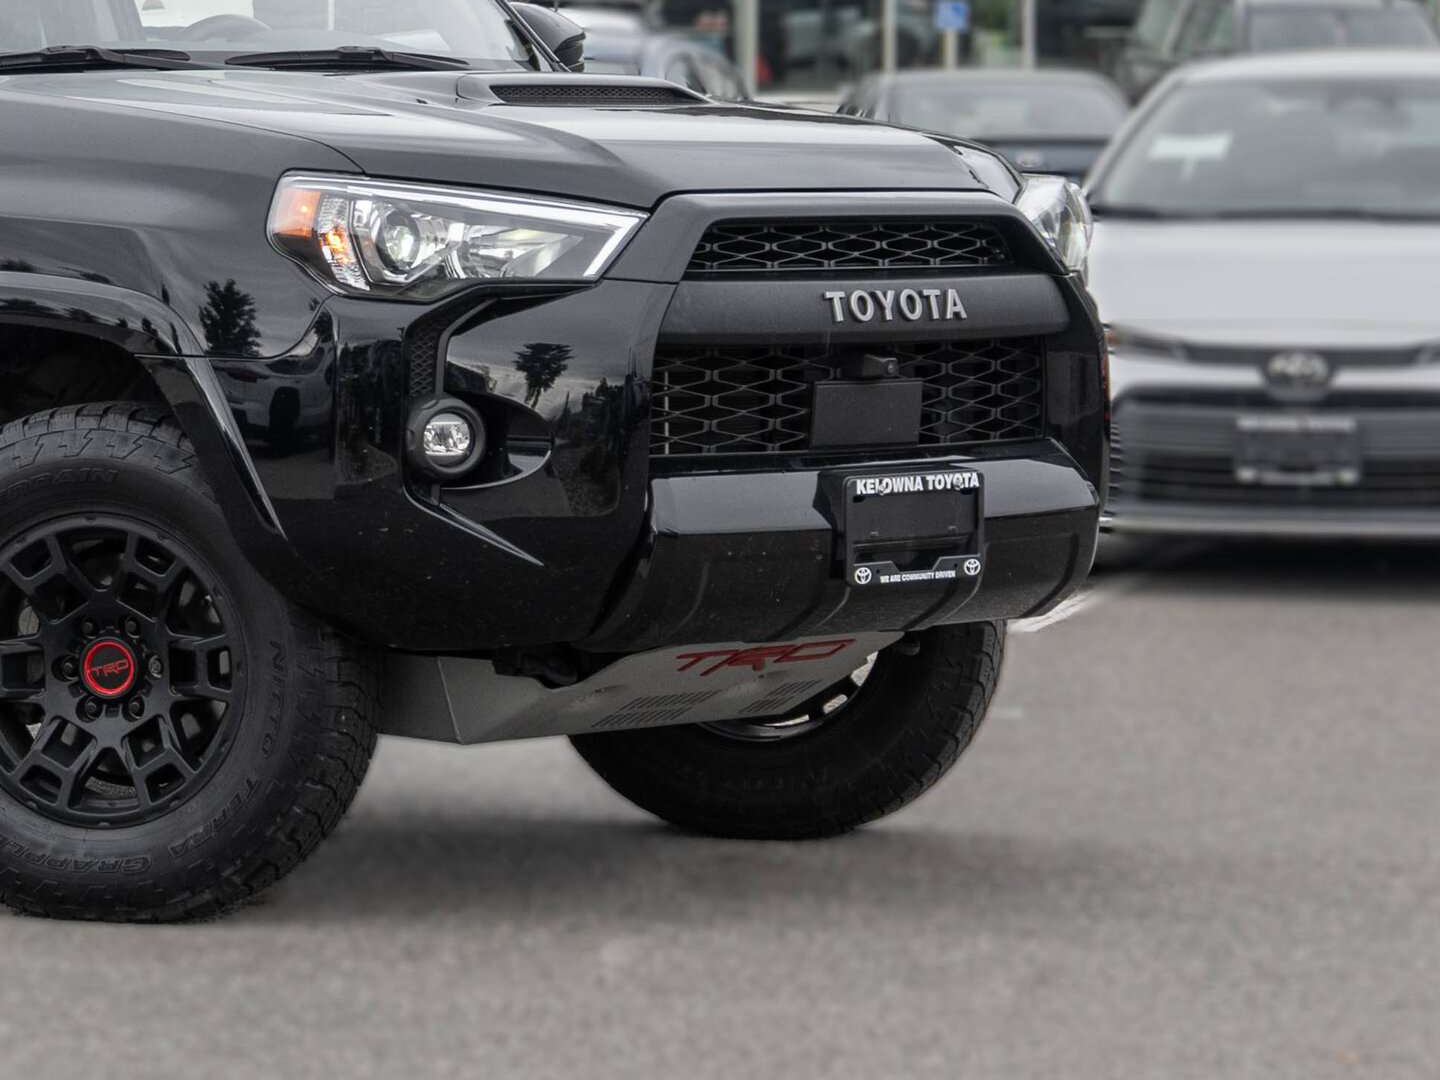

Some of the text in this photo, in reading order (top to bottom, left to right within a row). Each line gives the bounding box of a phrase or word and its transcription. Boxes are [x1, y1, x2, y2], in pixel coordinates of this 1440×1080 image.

[825, 288, 968, 322] TOYOTA
[925, 471, 980, 491] TOYOTA
[879, 570, 956, 583] WE ARE COMMUNITY DRIVEN
[675, 638, 857, 677] TRD
[90, 659, 130, 677] TRD
